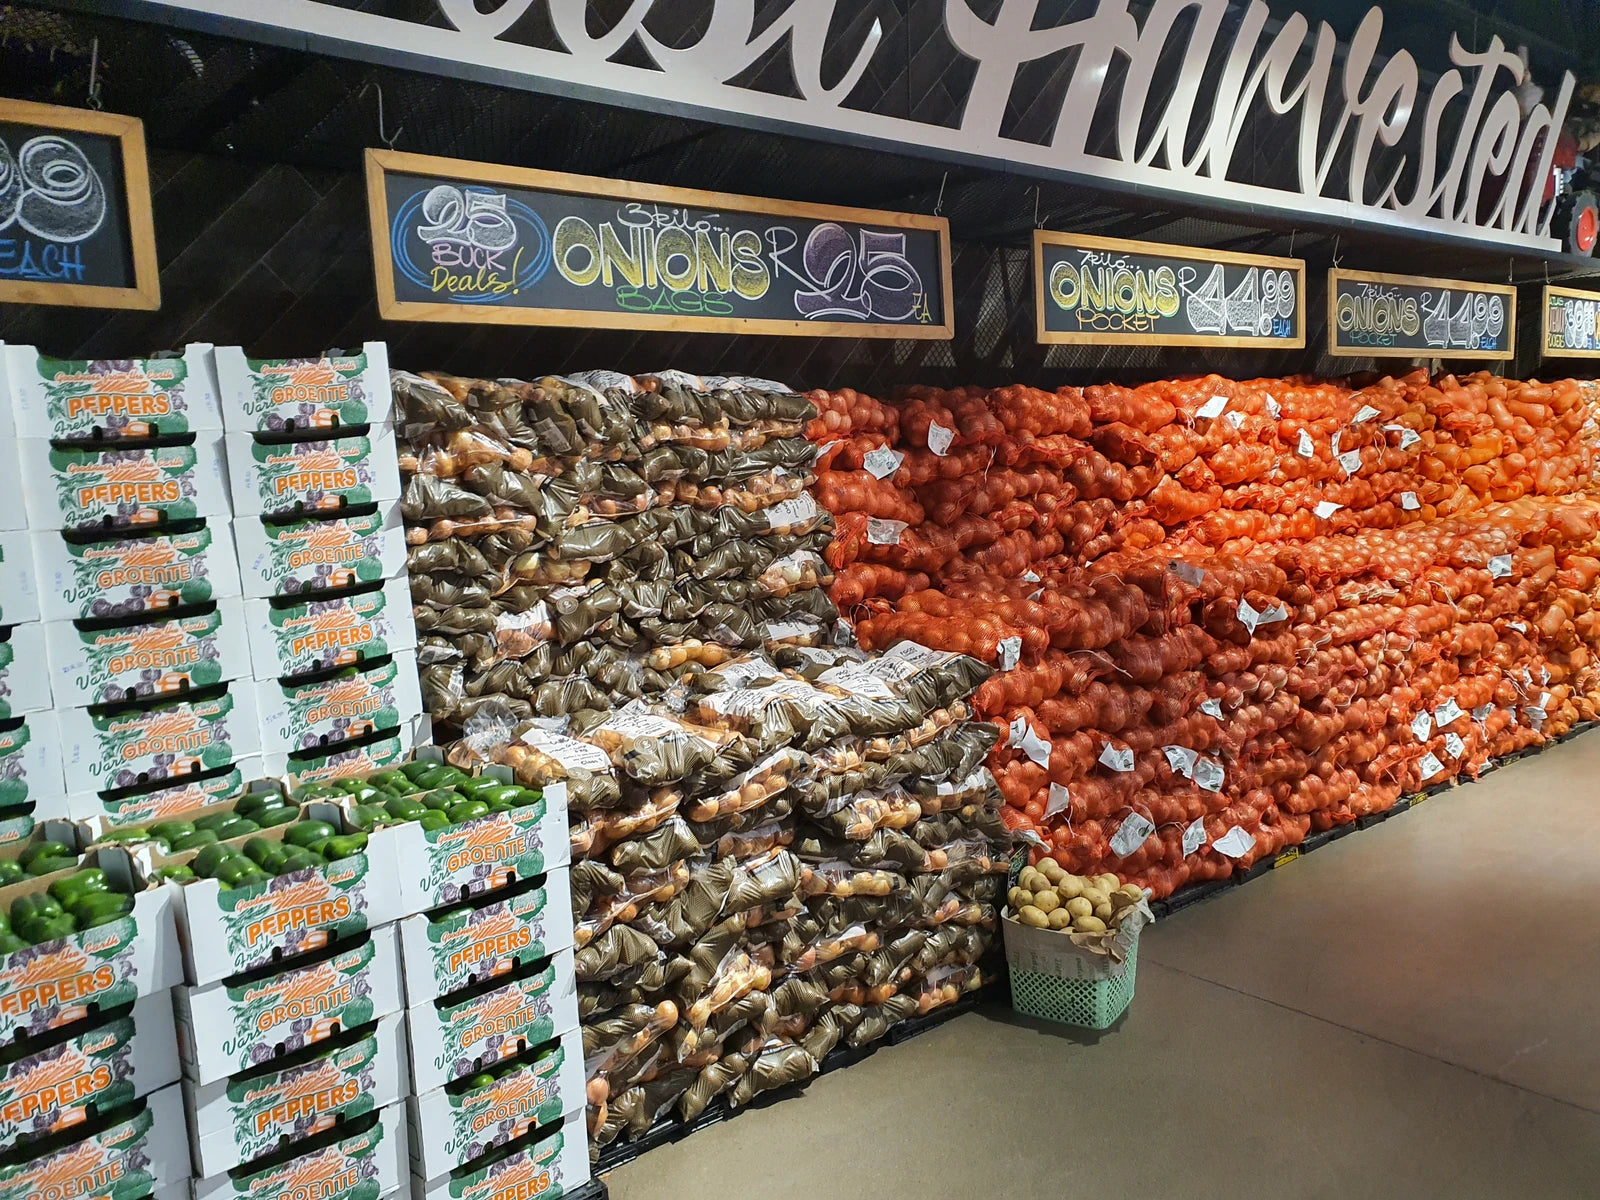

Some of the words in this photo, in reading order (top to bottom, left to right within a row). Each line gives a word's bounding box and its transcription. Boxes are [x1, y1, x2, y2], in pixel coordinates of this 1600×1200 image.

[416, 184, 518, 251] 25
[0, 239, 86, 281] EACH
[430, 246, 525, 295] Deals!
[431, 243, 507, 271] BUCK
[553, 215, 770, 300] ONIONS
[616, 285, 734, 315] BAGS
[1050, 260, 1181, 318] ONIONS
[1075, 307, 1161, 332] POCKET
[1272, 319, 1292, 337] EACH
[1336, 292, 1421, 337] ONIONS
[1349, 330, 1399, 347] POCKET
[68, 394, 170, 419] PEPPERS
[272, 385, 349, 406] GROENTE
[55, 413, 96, 432] Fresh
[80, 481, 180, 508] PEPPERS
[264, 488, 298, 509] Fresh
[275, 469, 357, 496] PEPPERS
[65, 501, 107, 522] Fresh
[289, 544, 365, 569] GROENTE
[97, 563, 191, 589] GROENTE
[293, 624, 372, 656] PEPPERS
[109, 645, 200, 674] GROENTE
[283, 649, 315, 671] Fresh
[306, 695, 382, 724] GROENTE
[121, 728, 212, 760] GROENTE
[437, 829, 473, 845] Goodness
[475, 822, 494, 836] from
[496, 813, 510, 826] the
[511, 811, 534, 824] Earth
[447, 837, 526, 873] GROENTE
[235, 891, 281, 912] Goodness
[282, 882, 306, 897] from
[307, 873, 324, 889] the
[327, 869, 355, 884] Earth
[247, 896, 350, 946] PEPPERS
[442, 924, 478, 942] Goodness
[479, 917, 497, 932] from
[499, 908, 511, 921] the
[513, 902, 535, 916] Earth
[235, 935, 275, 967] Fresh
[450, 927, 531, 974] PEPPERS
[0, 965, 115, 1016] EPPERS
[244, 981, 290, 1003] Goodness
[290, 972, 315, 987] from
[316, 962, 332, 976] the
[335, 957, 361, 971] Earth
[439, 964, 471, 992] Fresh
[257, 984, 352, 1032] GROENTE
[451, 1004, 486, 1022] Goodness
[486, 995, 506, 1009] from
[507, 986, 520, 999] the
[522, 980, 545, 994] Earth
[460, 1005, 536, 1048] GROENTE
[27, 1061, 56, 1080] from
[57, 1048, 79, 1064] the
[82, 1032, 117, 1056] Earth
[0, 1066, 110, 1123] EPPERS
[245, 1081, 292, 1102] Goodness
[293, 1071, 319, 1089] from
[320, 1061, 335, 1076] the
[338, 1053, 365, 1070] Earth
[462, 1089, 498, 1107] Goodness
[499, 1080, 518, 1095] from
[519, 1070, 532, 1083] the
[533, 1062, 555, 1076] Earth
[256, 1079, 359, 1134] PEPPERS
[471, 1086, 548, 1132] GROENTE
[46, 1154, 75, 1175] from
[79, 1139, 97, 1157] the
[101, 1127, 136, 1147] Earth
[241, 1123, 283, 1156] Fresh
[250, 1168, 297, 1191] Goodness
[299, 1158, 323, 1176] from
[324, 1147, 339, 1161] the
[342, 1140, 369, 1156] Earth
[462, 1175, 498, 1197] Goodness
[498, 1167, 519, 1182] from
[519, 1155, 532, 1170] the
[533, 1147, 554, 1163] Earth
